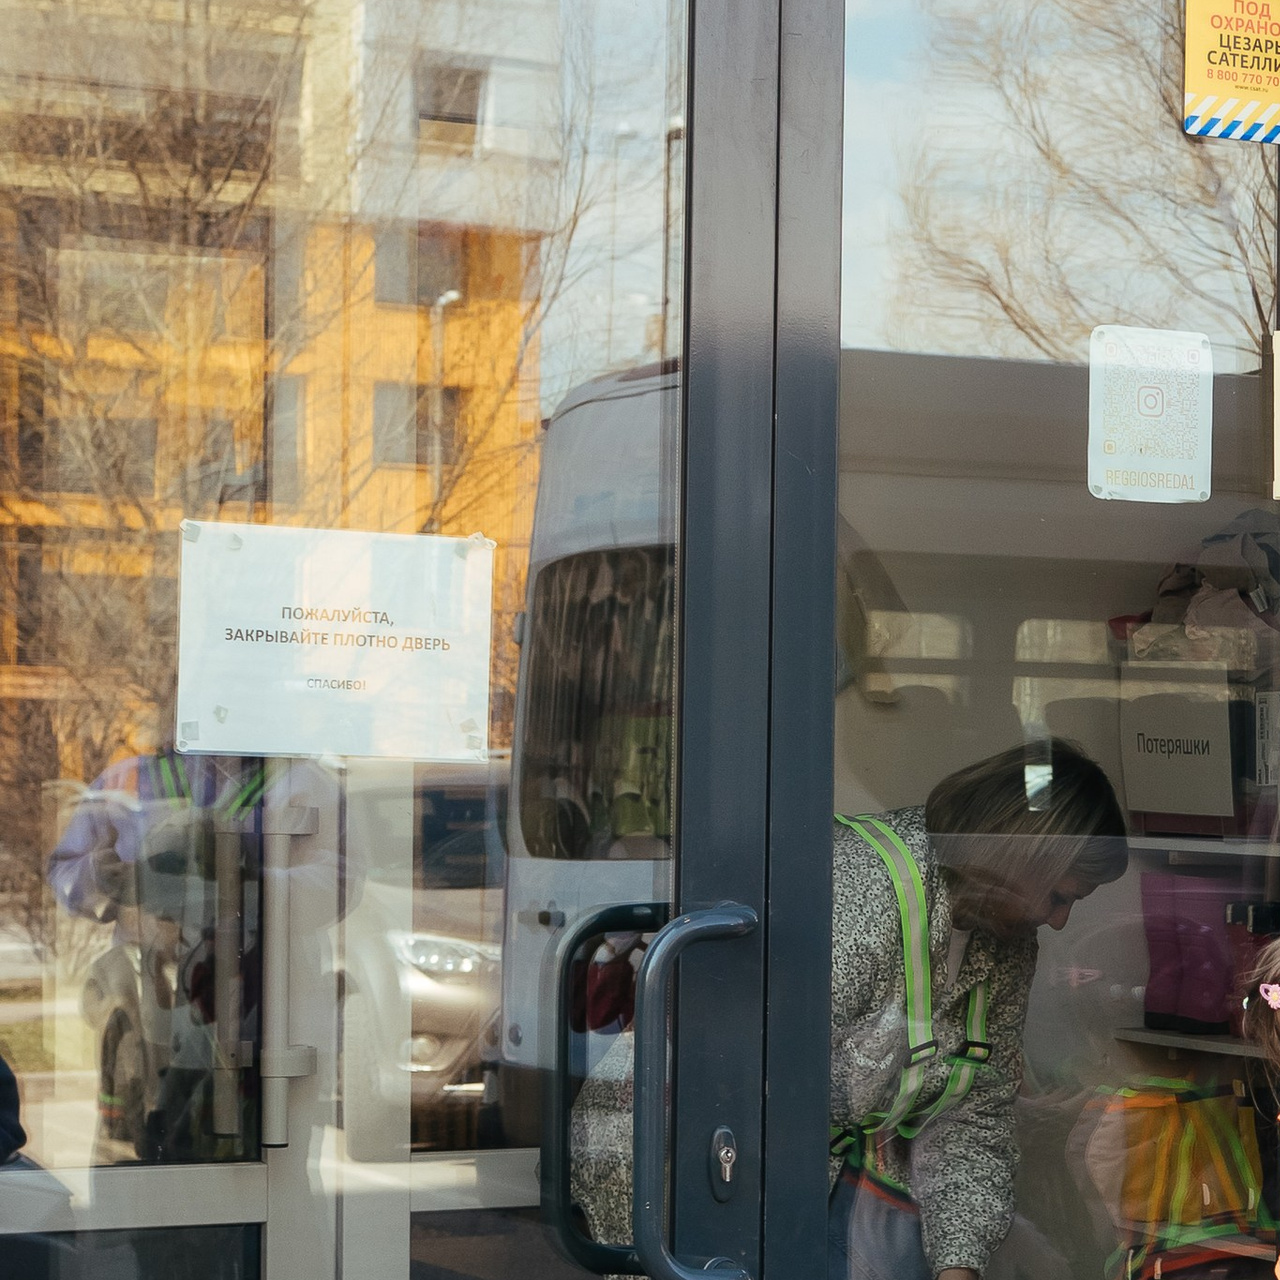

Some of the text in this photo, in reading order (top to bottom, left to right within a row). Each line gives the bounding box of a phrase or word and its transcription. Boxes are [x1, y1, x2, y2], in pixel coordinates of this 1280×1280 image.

[1233, 0, 1272, 20] ПОД
[1206, 68, 1214, 79] 8
[1217, 69, 1238, 82] 800
[1241, 72, 1263, 85] 770
[1266, 75, 1280, 87] 70
[1105, 469, 1195, 491] REGGIOSREDA1
[281, 606, 395, 626] ПОЖАЛУЙСТА,
[224, 627, 451, 652] ЗАКРЫВАЙТЕ ПЛОТНО ДВЕРЬ
[306, 677, 367, 691] СПАСИБО!
[1137, 733, 1211, 759] Потеряшки
